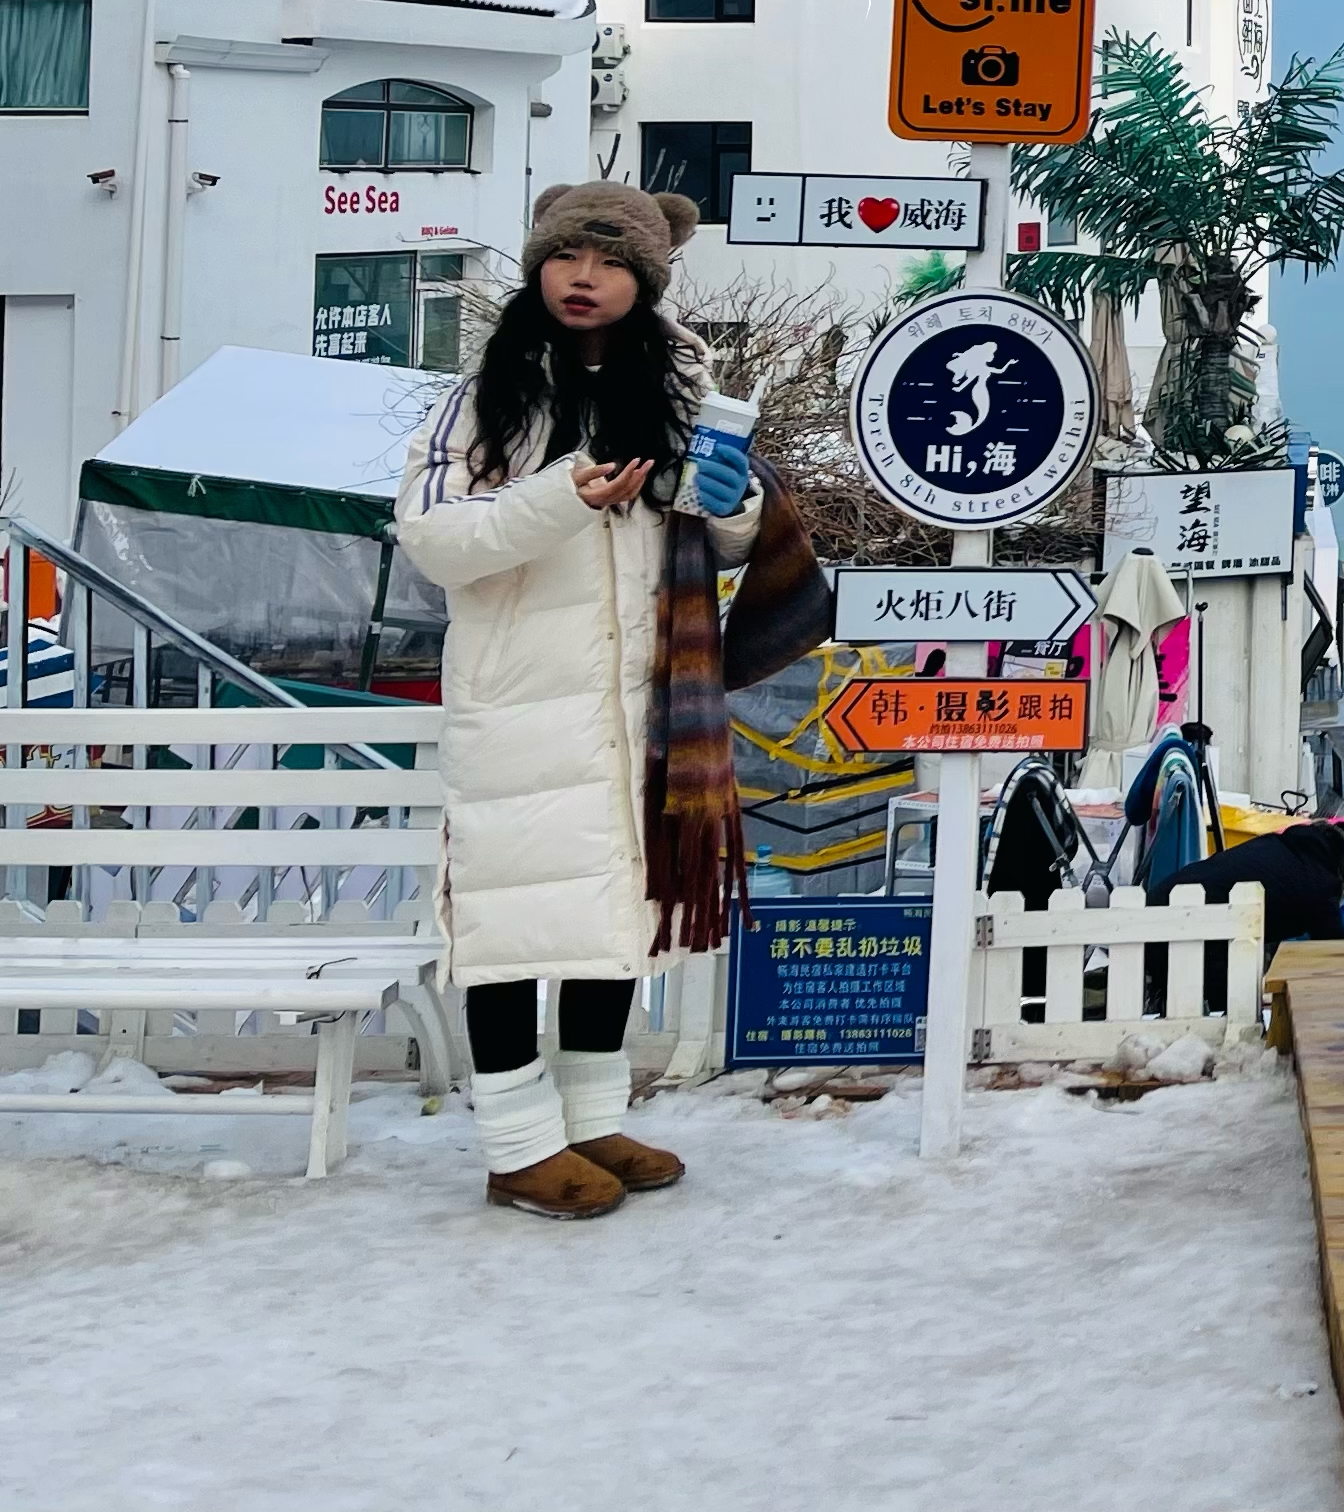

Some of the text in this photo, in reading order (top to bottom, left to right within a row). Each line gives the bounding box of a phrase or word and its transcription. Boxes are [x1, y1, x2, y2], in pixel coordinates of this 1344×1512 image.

[995, 97, 1053, 121] Stay
[324, 185, 399, 214] See Sea
[819, 196, 968, 232] 我 威海
[315, 303, 392, 330] 允许本店客人
[958, 305, 993, 323] 토치
[1007, 312, 1055, 345] 8번가
[314, 331, 368, 357] 先富起来
[868, 393, 1086, 513] Torch 8th street weihai
[1177, 480, 1212, 553] 望海
[873, 589, 1019, 622] 火炬八街
[770, 936, 923, 959] 请不要乱扔垃圾
